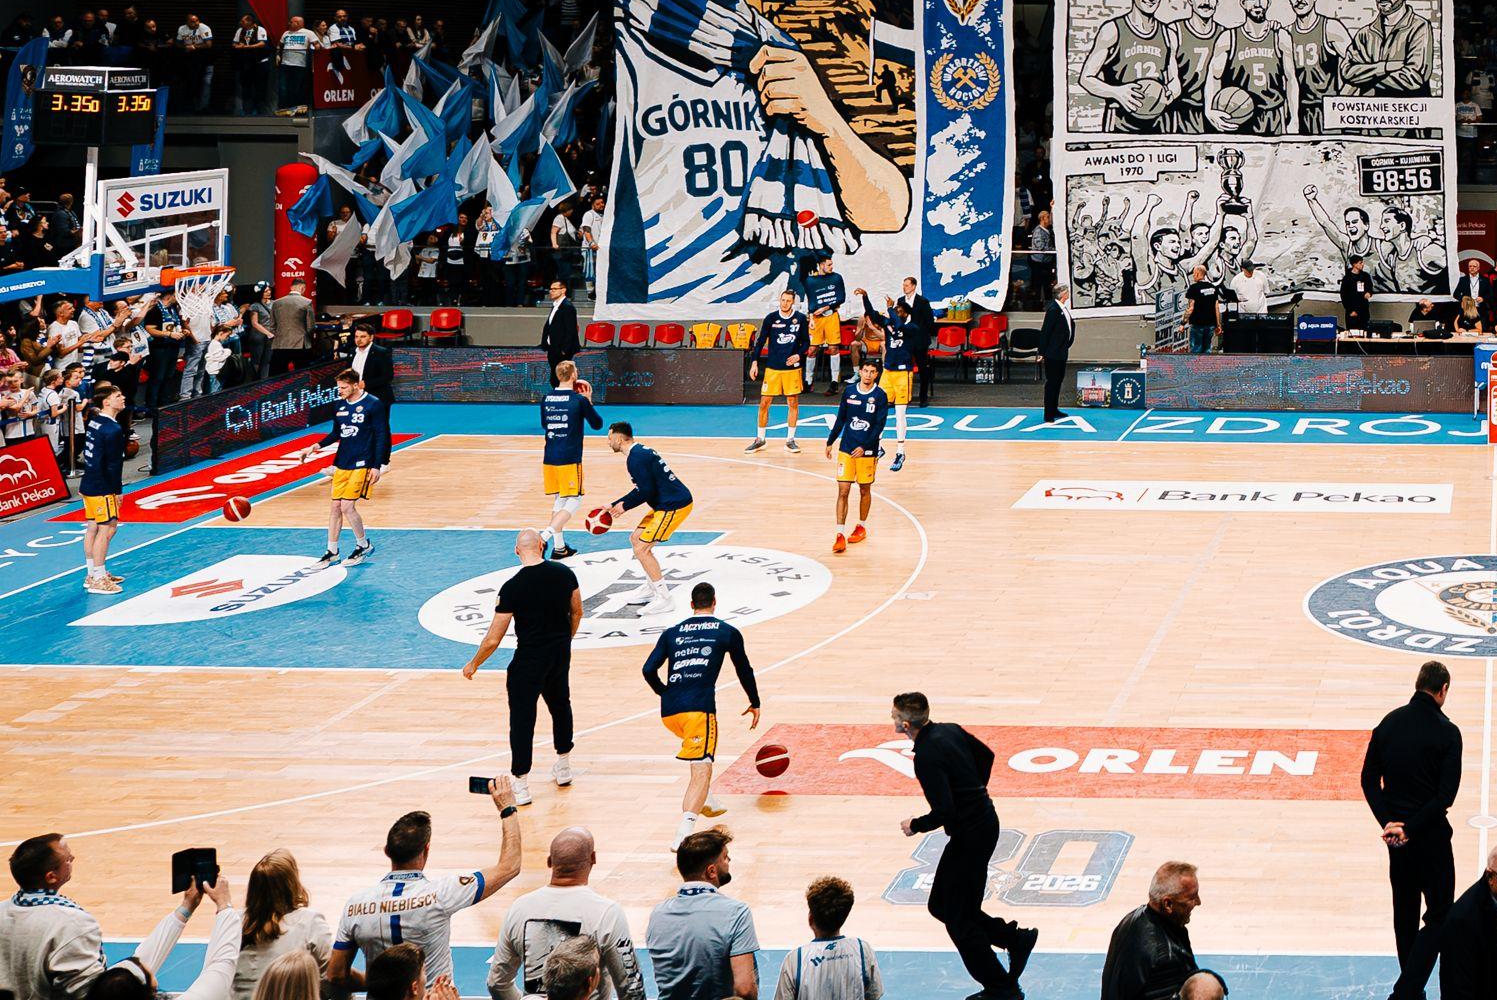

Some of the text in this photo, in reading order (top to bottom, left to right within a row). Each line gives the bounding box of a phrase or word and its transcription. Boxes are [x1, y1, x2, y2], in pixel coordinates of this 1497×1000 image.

[1125, 42, 1162, 58] GÓRNIK
[1238, 48, 1274, 61] GÓRNIK
[1295, 43, 1319, 66] 13
[1194, 48, 1208, 72] 7
[1134, 62, 1159, 78] 12
[1253, 64, 1266, 86] 5
[48, 74, 102, 83] AEROWATCH
[109, 75, 147, 83] AEROWATCH
[324, 89, 354, 102] ORLEN
[642, 95, 765, 136] GÓRNIK
[1332, 103, 1427, 112] POWSTANIE SEKCJI
[1340, 116, 1420, 125] KOSZYKARSKIEJ
[683, 140, 749, 197] 80
[1085, 154, 1177, 167] AWANS DO LIGI
[1120, 165, 1143, 176] 1970
[1373, 169, 1432, 191] 98:56
[139, 187, 212, 212] SUZUKI
[281, 270, 305, 278] ORLEN
[789, 324, 800, 332] 37
[866, 403, 875, 413] 10
[351, 413, 364, 423] 33
[1133, 414, 1489, 438] ZDRÓJ
[22, 487, 55, 504] Pekao
[1157, 490, 1437, 504] Bank Pekao
[1347, 558, 1487, 590] AQUA
[1327, 609, 1484, 653] ZDRÓJ
[675, 647, 700, 657] netia
[1007, 746, 1320, 776] ORLEN
[1020, 873, 1102, 893] 2026
[347, 902, 378, 919] BIAŁO
